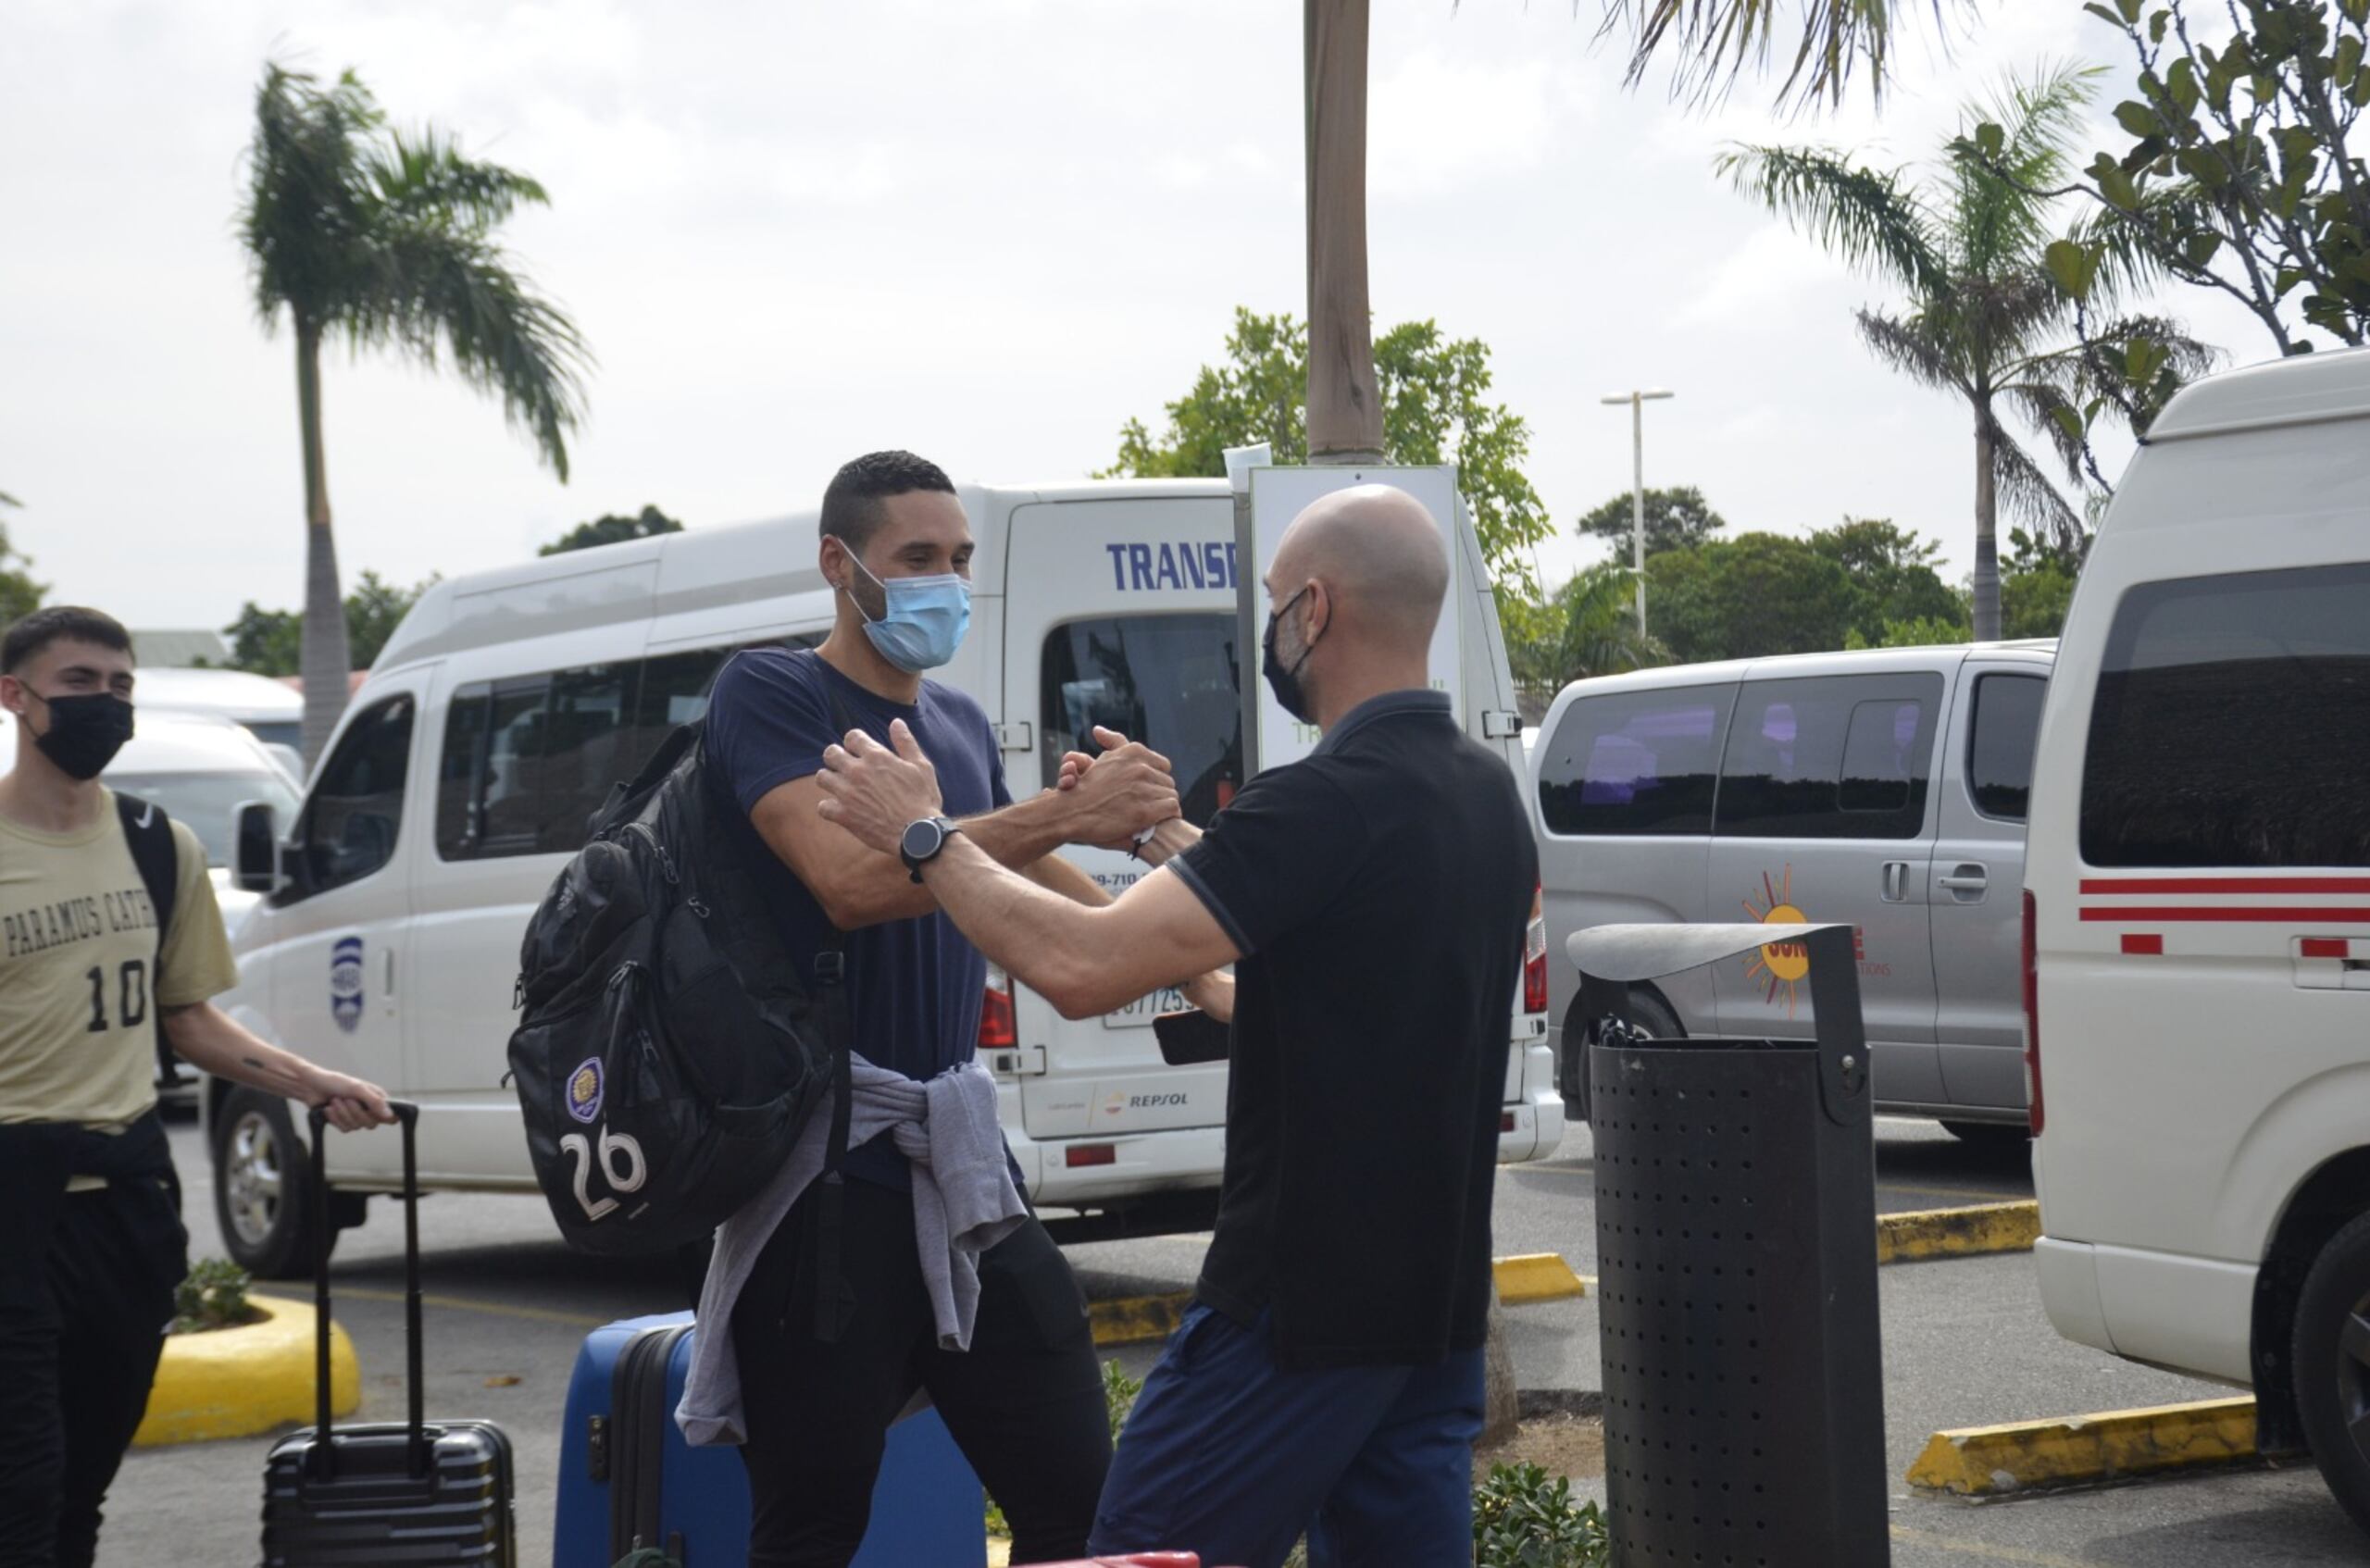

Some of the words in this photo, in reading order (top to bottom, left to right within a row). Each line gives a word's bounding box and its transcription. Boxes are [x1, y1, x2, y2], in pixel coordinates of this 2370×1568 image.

[4, 896, 102, 957] PARAMUS
[87, 959, 145, 1033] 10
[1129, 1092, 1189, 1109] REPSOL
[559, 1123, 647, 1222] 26
